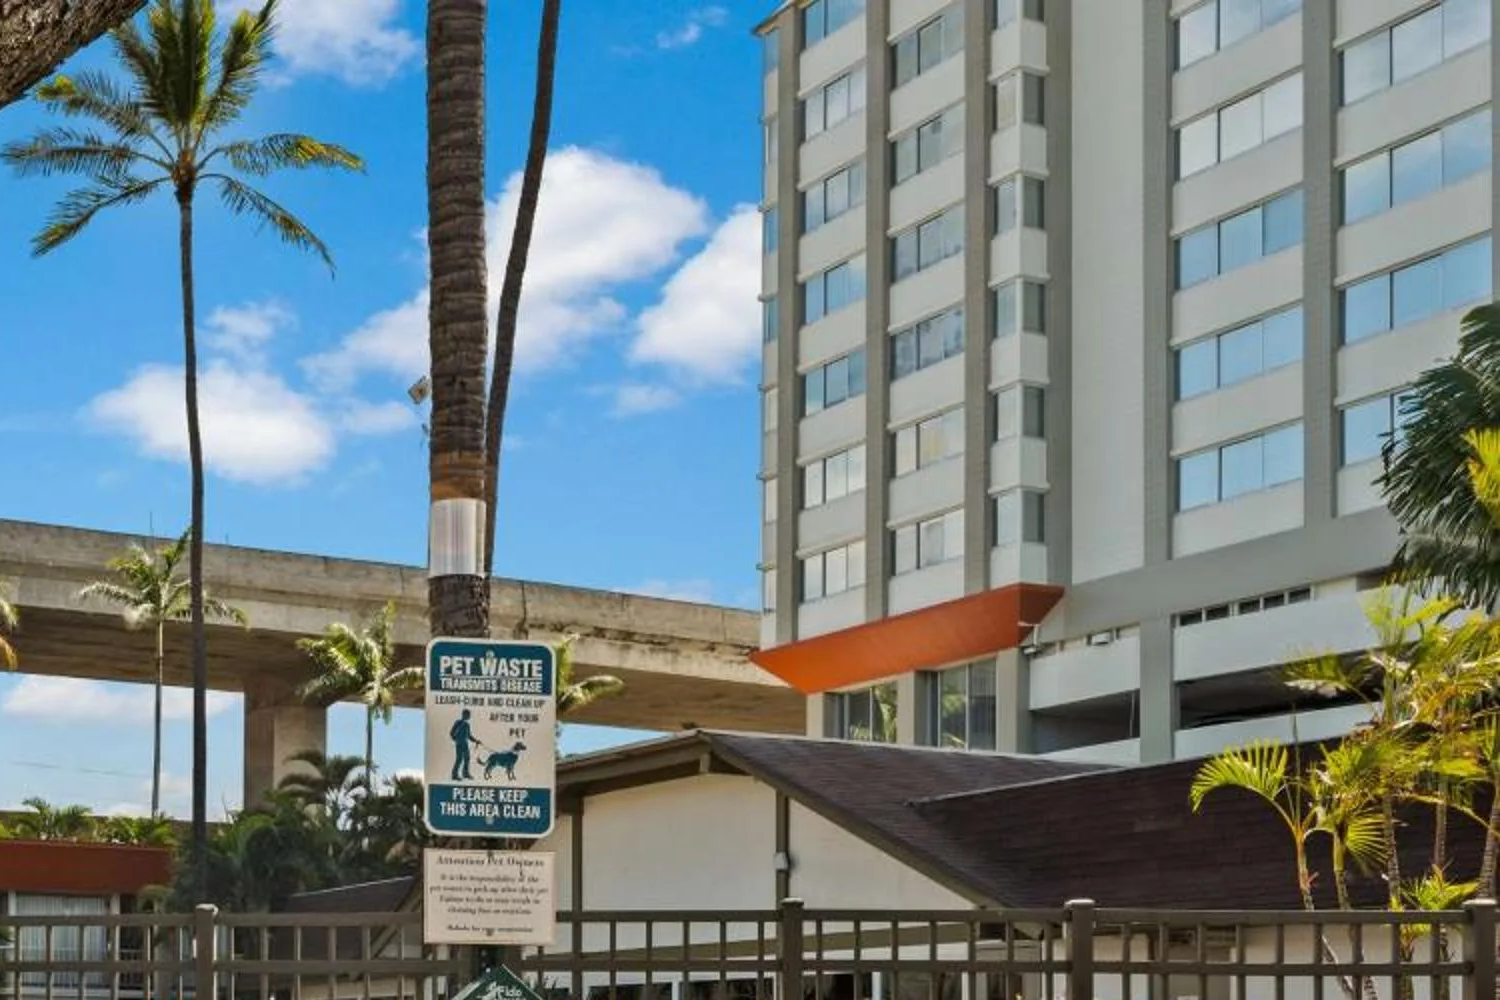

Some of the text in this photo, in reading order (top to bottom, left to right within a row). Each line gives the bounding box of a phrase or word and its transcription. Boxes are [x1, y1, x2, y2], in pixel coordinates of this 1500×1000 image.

[440, 655, 543, 678] PET WASTE
[440, 678, 543, 693] TRANSMITS DISEASE
[506, 698, 532, 708] CLEAN
[534, 700, 546, 708] UP
[490, 713, 539, 722] AFTER YOUR
[509, 728, 526, 737] PET
[452, 787, 529, 803] PLEASE KEEP
[440, 801, 541, 818] THIS AREA CLEAN
[498, 985, 522, 997] Fido
